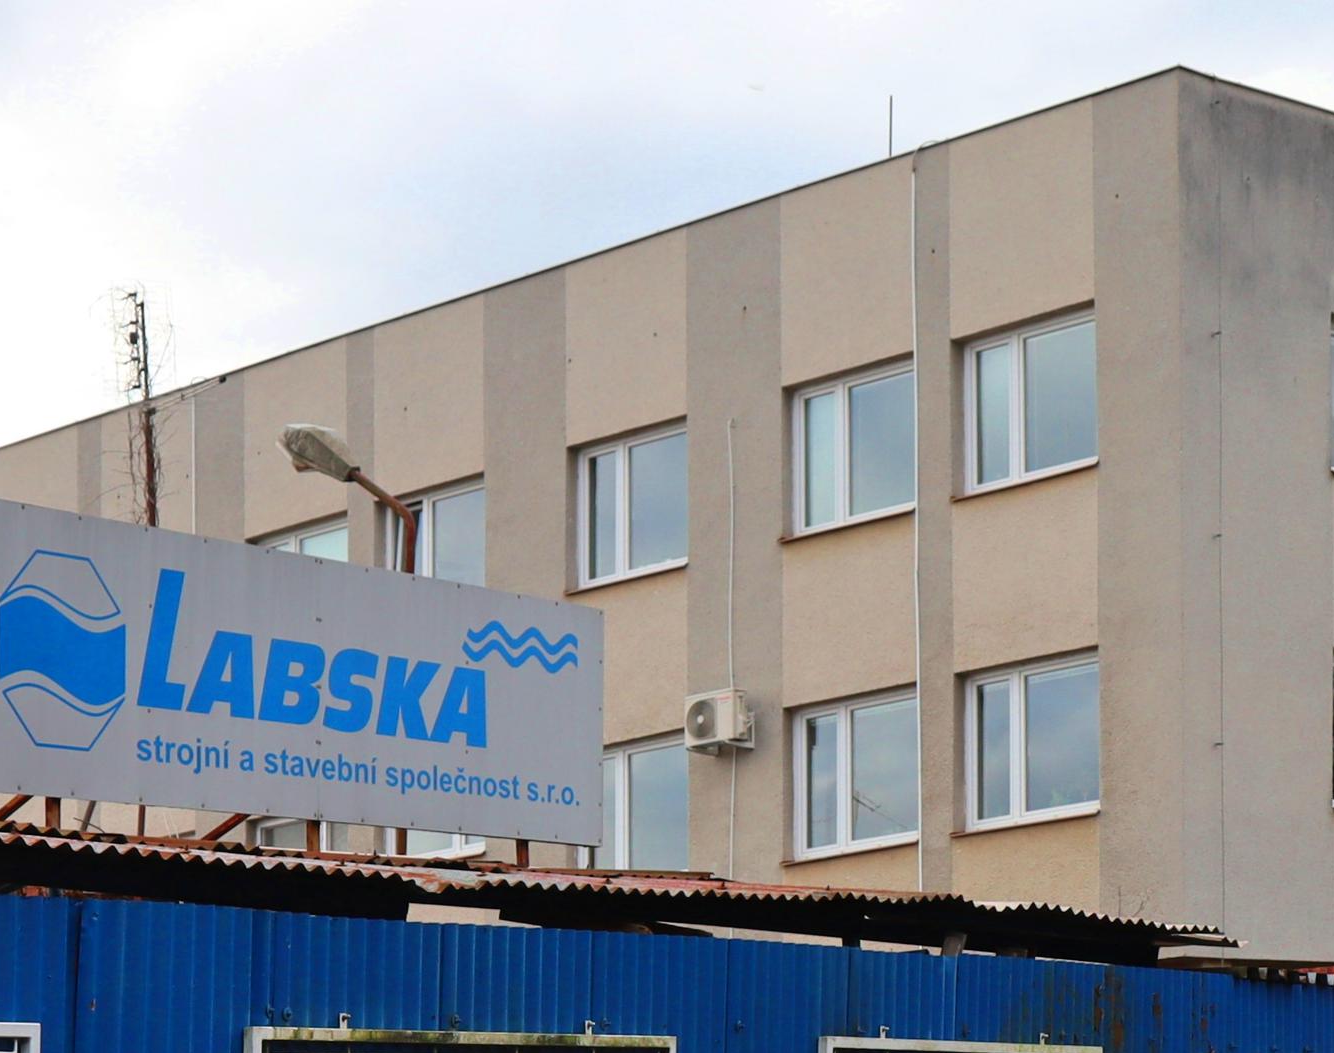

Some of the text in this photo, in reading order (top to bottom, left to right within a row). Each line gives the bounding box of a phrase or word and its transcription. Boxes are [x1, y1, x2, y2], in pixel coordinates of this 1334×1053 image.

[136, 736, 581, 806] strojní a stavební společnost s.r.o.
